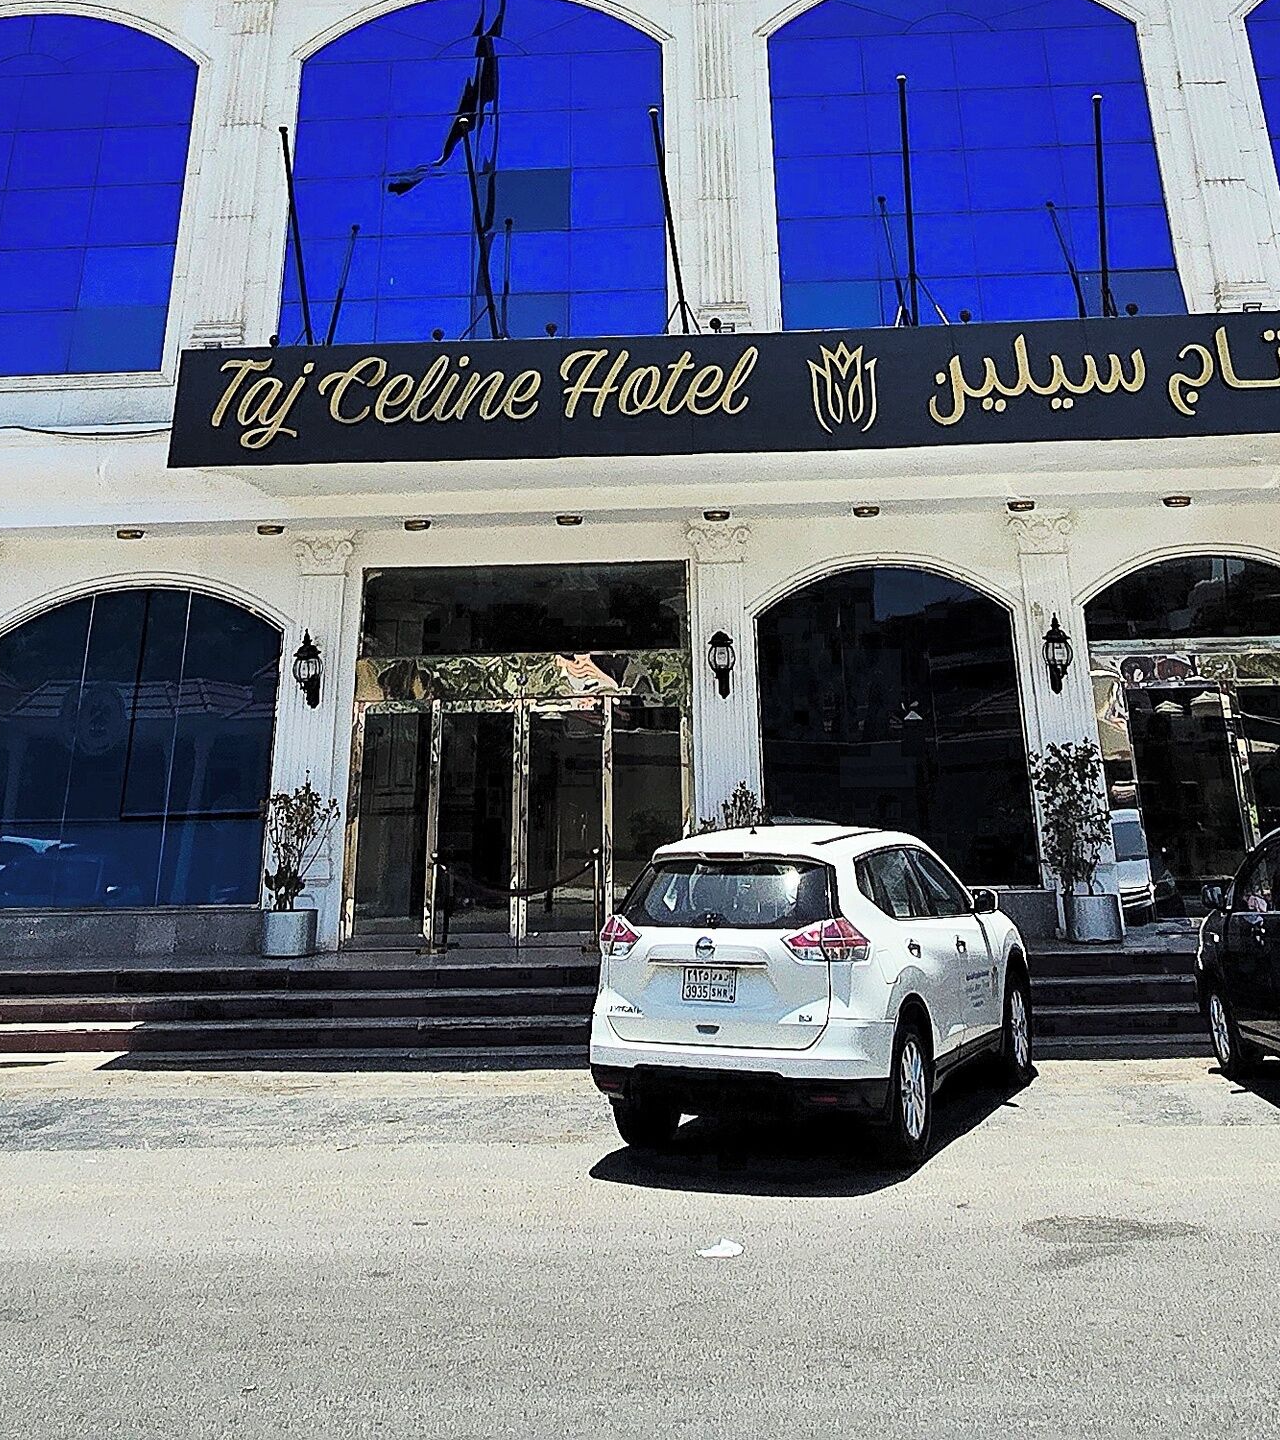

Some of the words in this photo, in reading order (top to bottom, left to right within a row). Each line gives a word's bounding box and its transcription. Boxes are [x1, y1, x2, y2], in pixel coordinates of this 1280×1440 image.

[211, 357, 314, 449] Taj
[319, 356, 539, 424] Celine
[560, 346, 758, 419] Hotel
[929, 334, 1146, 426] سيلين
[686, 985, 708, 998] 3935
